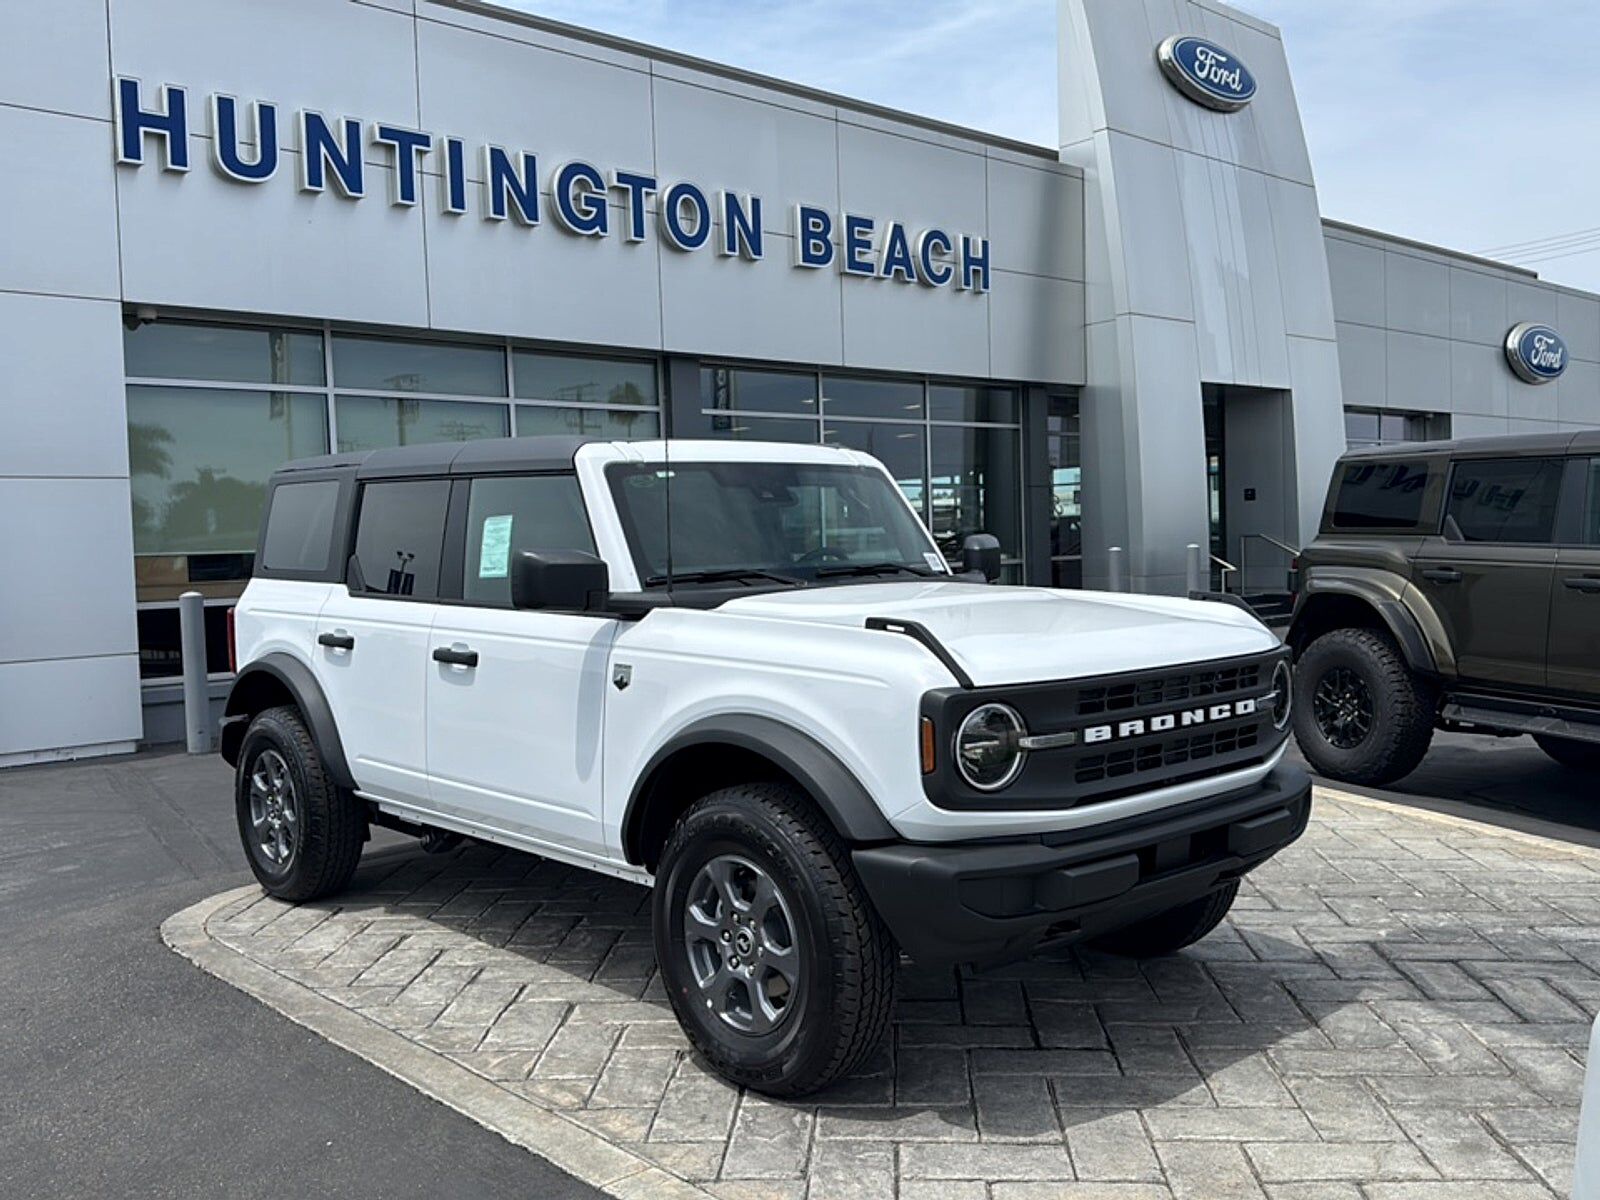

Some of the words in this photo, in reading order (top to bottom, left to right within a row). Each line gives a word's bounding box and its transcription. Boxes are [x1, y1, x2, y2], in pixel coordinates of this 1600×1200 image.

[1195, 46, 1243, 92] Ford
[115, 75, 764, 261] HUNTINGTON
[794, 203, 991, 293] BEACH
[1531, 334, 1563, 369] Ford
[1084, 699, 1255, 743] BRONCO
